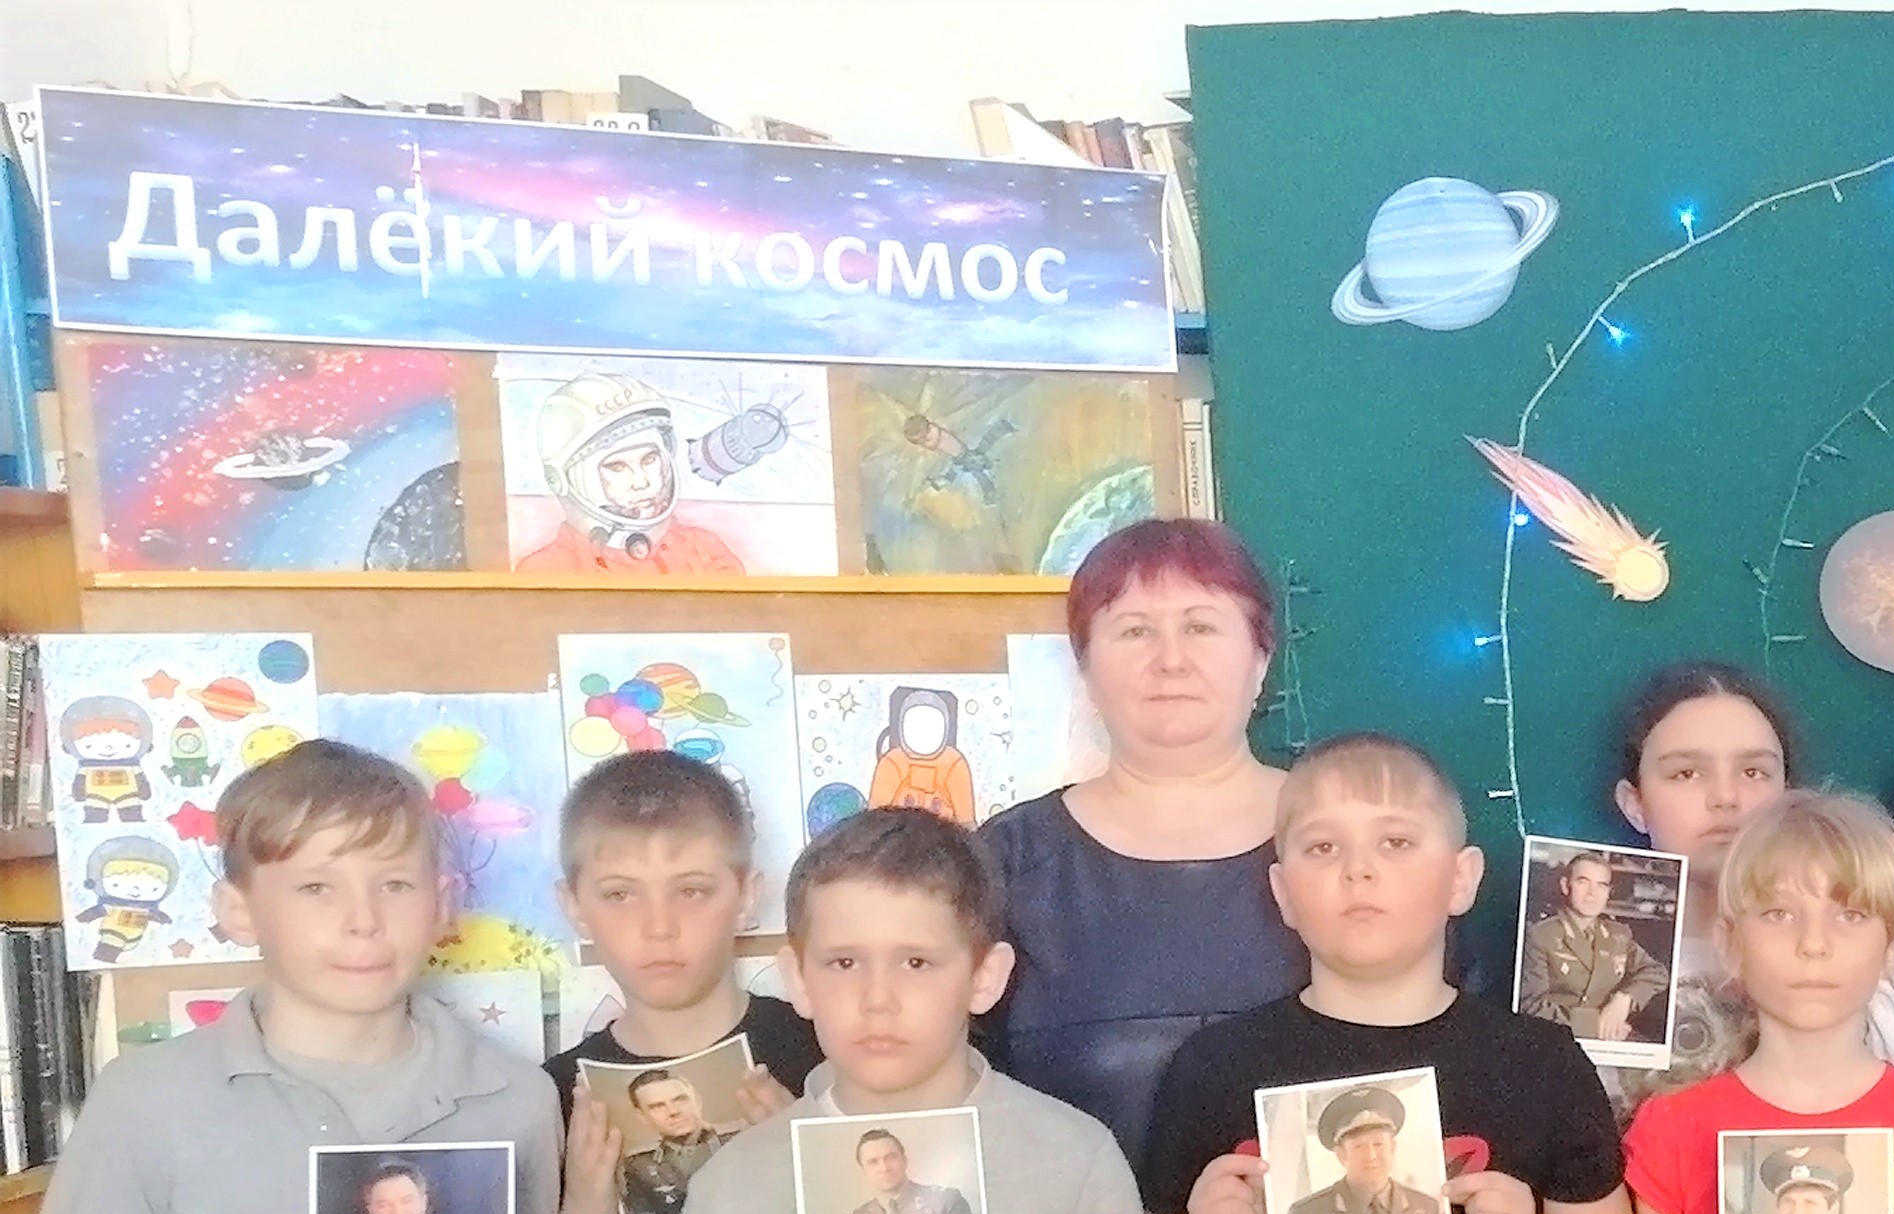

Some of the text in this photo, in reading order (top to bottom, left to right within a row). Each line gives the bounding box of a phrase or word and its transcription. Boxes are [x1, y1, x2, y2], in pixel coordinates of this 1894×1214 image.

[108, 170, 1071, 306] Далёкий космос
[594, 387, 633, 416] СССР
